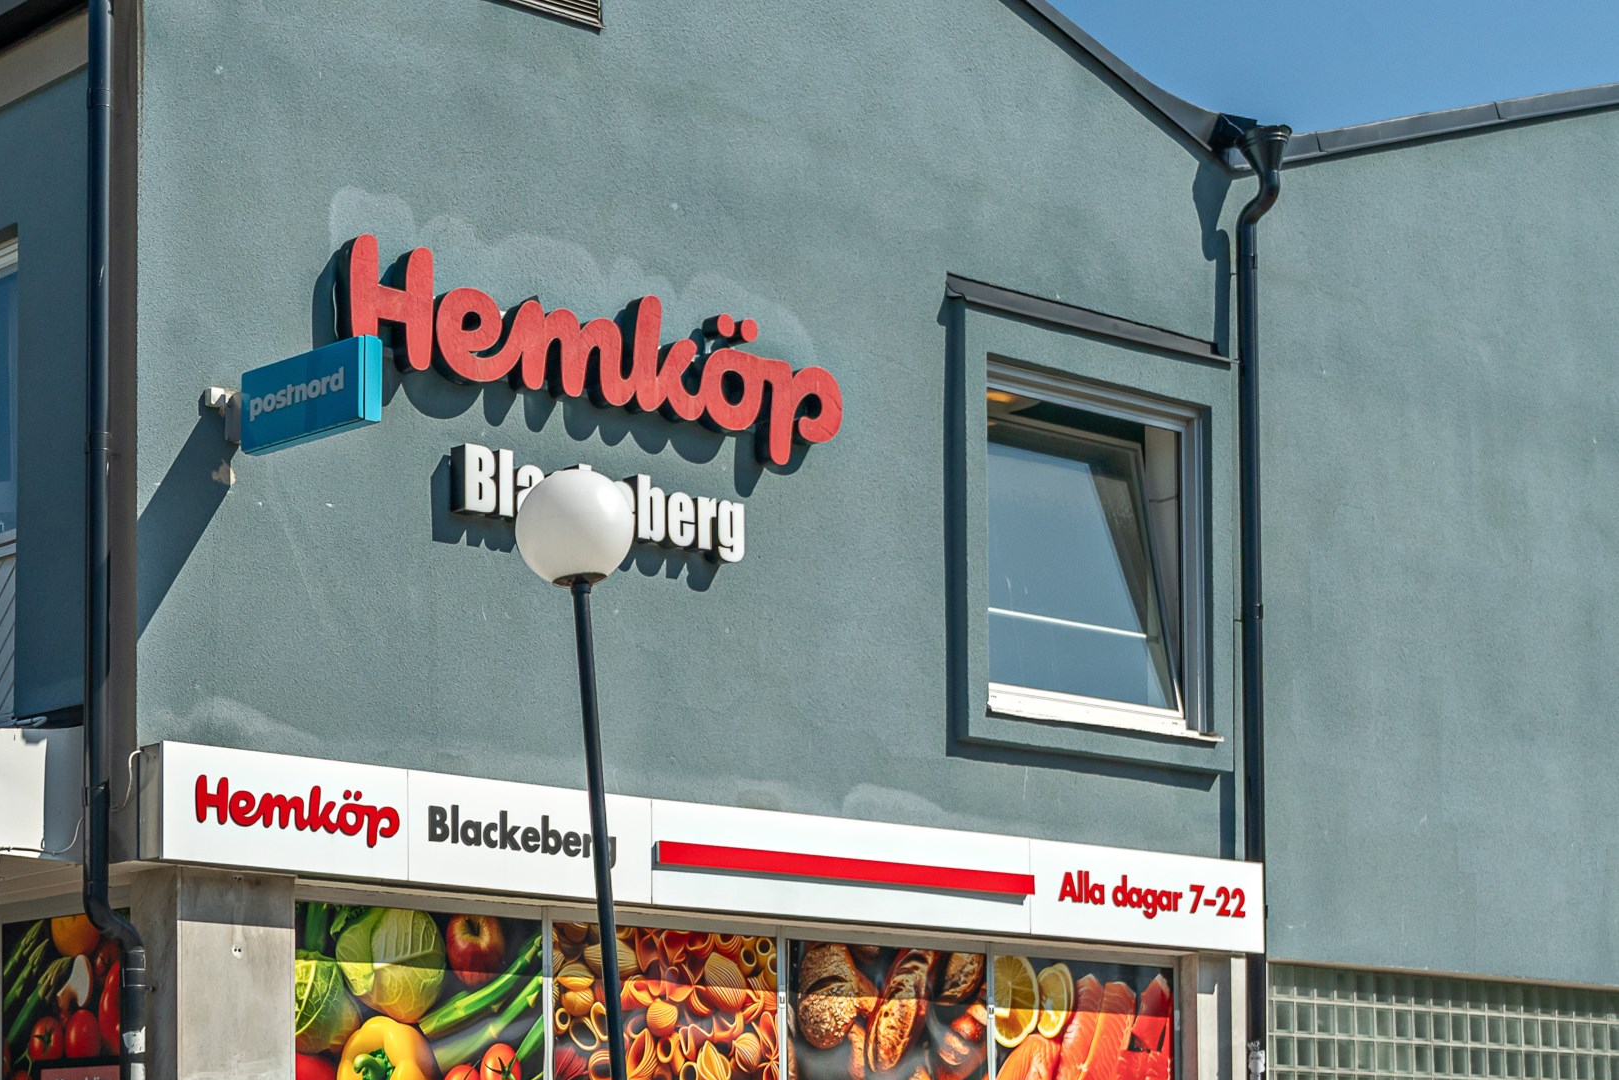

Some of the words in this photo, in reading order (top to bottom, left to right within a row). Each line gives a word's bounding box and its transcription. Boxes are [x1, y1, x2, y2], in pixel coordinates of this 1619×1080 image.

[348, 233, 844, 467] Hemköp
[247, 365, 345, 423] postnord
[464, 442, 746, 563] Blaberg
[194, 773, 401, 849] Hemköp
[1058, 870, 1105, 905] Alla
[1112, 874, 1183, 919] dagar
[1189, 884, 1246, 918] 7-22
